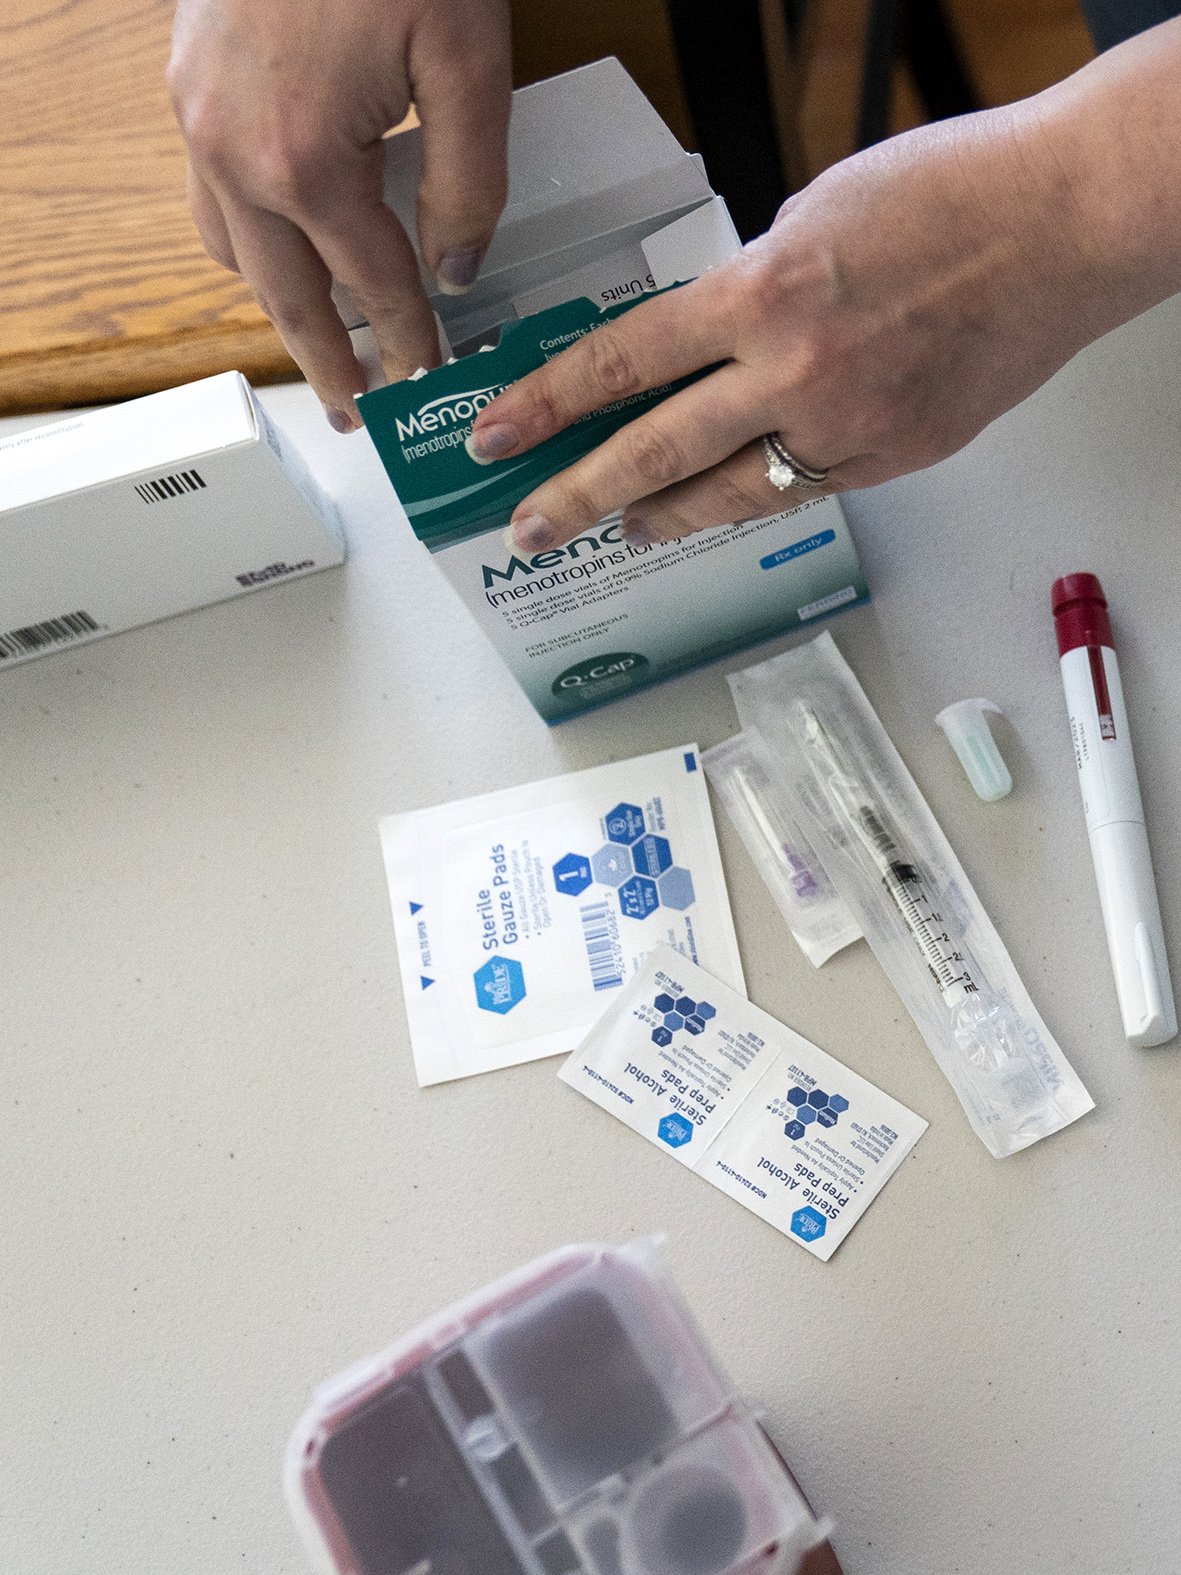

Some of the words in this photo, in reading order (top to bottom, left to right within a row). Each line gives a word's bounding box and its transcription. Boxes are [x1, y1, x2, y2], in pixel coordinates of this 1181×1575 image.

[600, 279, 644, 302] Units
[774, 551, 792, 563] Rx
[794, 537, 822, 554] only
[485, 547, 626, 608] (menotropins
[511, 600, 544, 615] single
[546, 590, 572, 603] dose
[574, 581, 598, 594] vials
[599, 576, 610, 584] of
[612, 549, 680, 580] Menotropins
[681, 543, 696, 553] for
[698, 524, 744, 546] Injection
[515, 606, 548, 621] single
[550, 597, 576, 610] dose
[577, 587, 601, 599] vials
[603, 581, 614, 591] of
[643, 556, 685, 575] Sodium
[686, 538, 730, 559] Chloride
[732, 518, 779, 541] Injection,
[560, 603, 580, 614] Vial
[582, 586, 629, 607] Adapters
[525, 642, 546, 653] FOR
[547, 613, 629, 645] SUBCUTANEOUS
[528, 639, 581, 659] INJECTION
[582, 626, 610, 641] ONLY
[489, 843, 508, 887] Pads
[558, 870, 579, 881] 1
[476, 889, 498, 950] Sterile
[498, 890, 518, 944] Gauze
[941, 931, 950, 942] 2
[962, 970, 971, 981] 3
[623, 1062, 667, 1096] Alcohol
[660, 1069, 689, 1094] Pads
[669, 1094, 707, 1126] Sterile
[688, 1088, 716, 1113] Prep
[790, 1143, 811, 1161] Needed
[809, 1144, 826, 1159] Pouch
[813, 1137, 839, 1157] Damaged
[837, 1154, 846, 1162] Or
[756, 1156, 800, 1190] Alcohol
[810, 1157, 819, 1165] As
[816, 1161, 839, 1181] Topically
[825, 1155, 843, 1170] Unless
[844, 1158, 865, 1176] Opened
[793, 1162, 822, 1188] Pads
[838, 1176, 854, 1190] Apply
[842, 1167, 860, 1182] Sterile
[801, 1187, 840, 1219] Sterile
[821, 1181, 849, 1207] Prep
